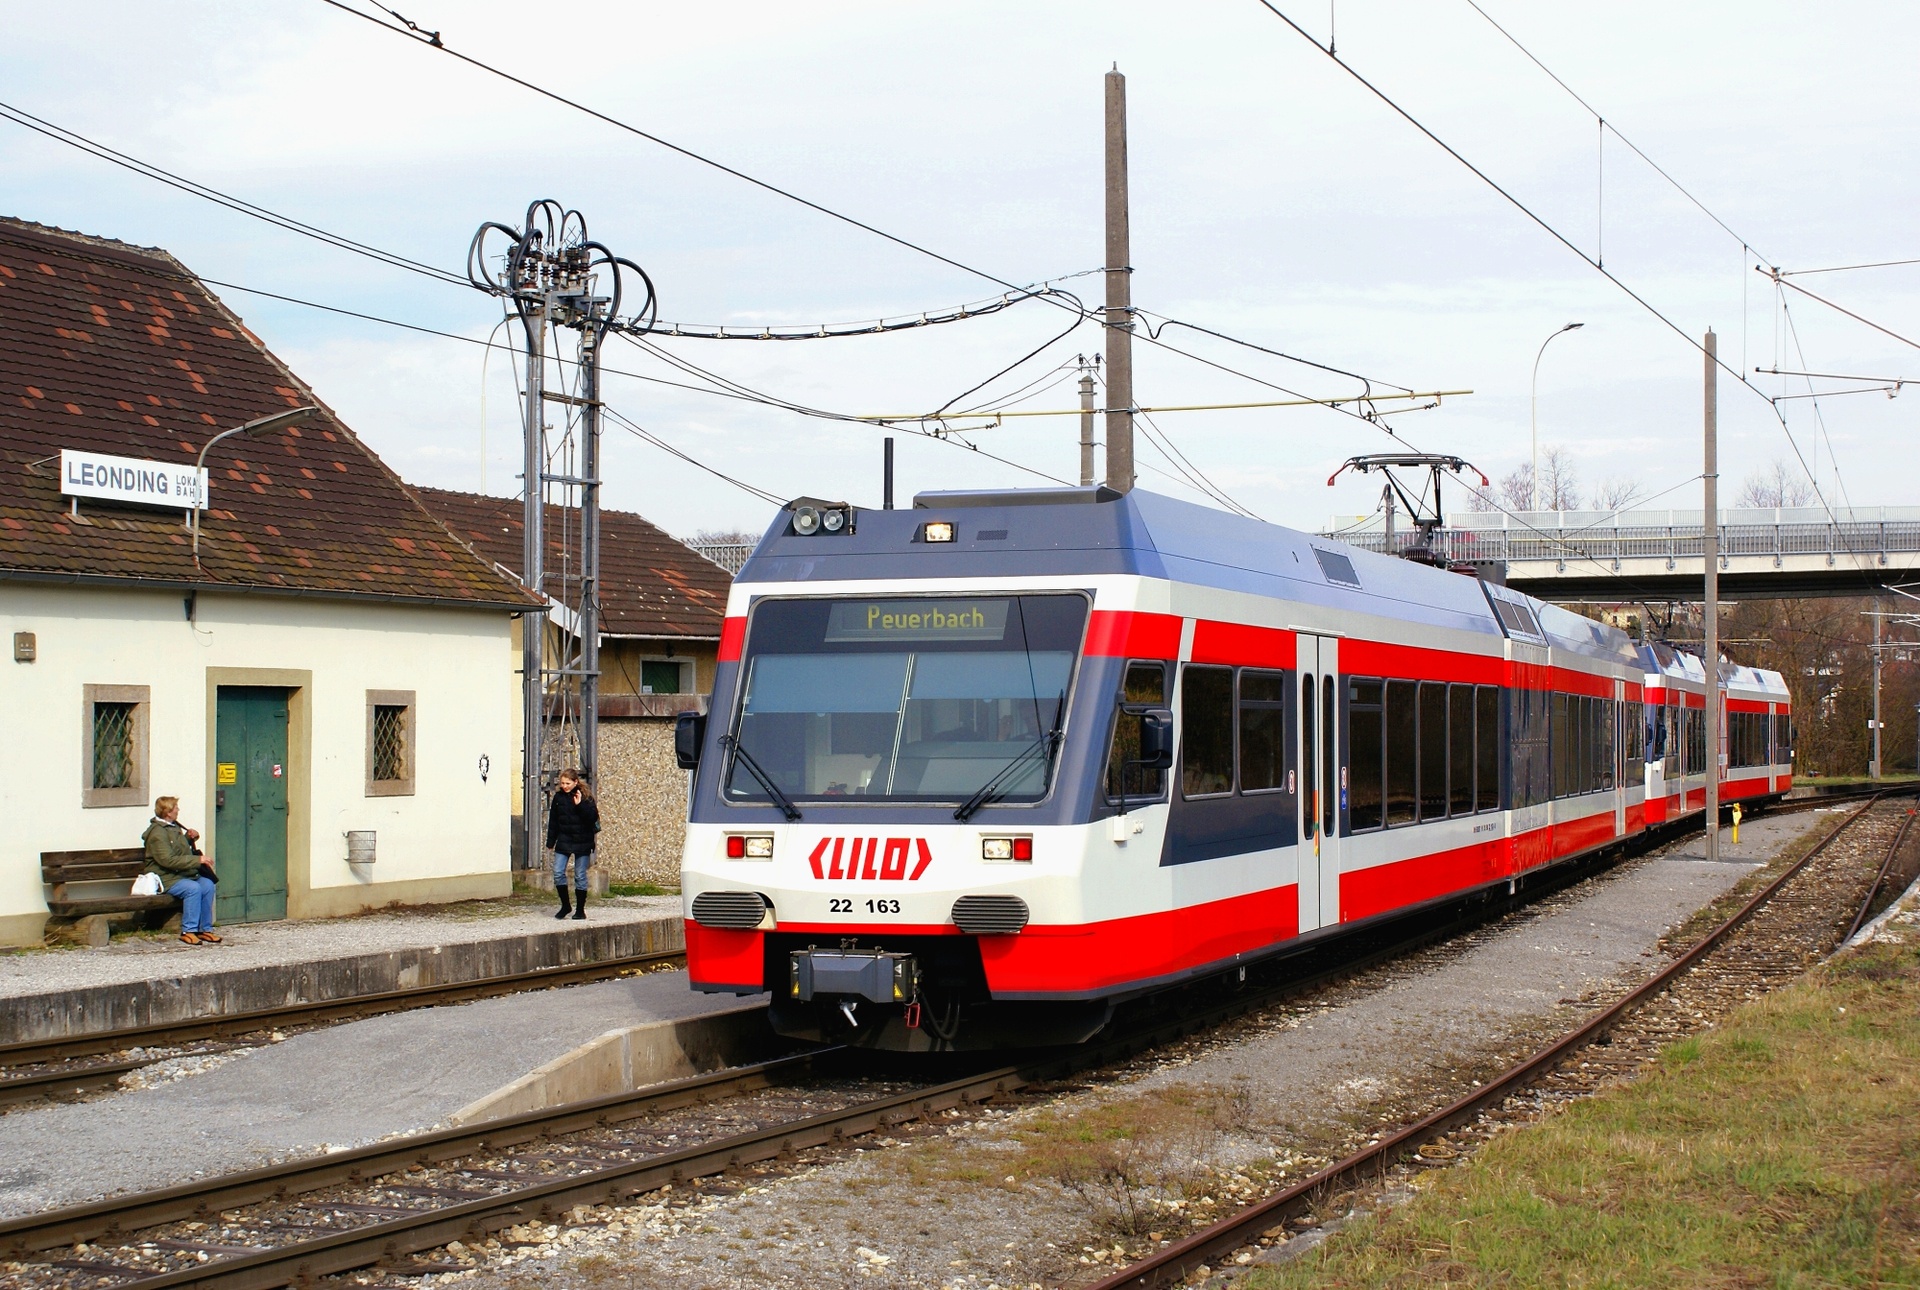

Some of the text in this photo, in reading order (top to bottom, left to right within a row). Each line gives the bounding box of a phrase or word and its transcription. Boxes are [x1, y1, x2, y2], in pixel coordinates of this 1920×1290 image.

[68, 461, 169, 495] LEONDING
[176, 474, 203, 488] LOKA
[867, 605, 984, 629] Peuerbach
[828, 837, 911, 880] LILO
[829, 898, 901, 913] 22 163
